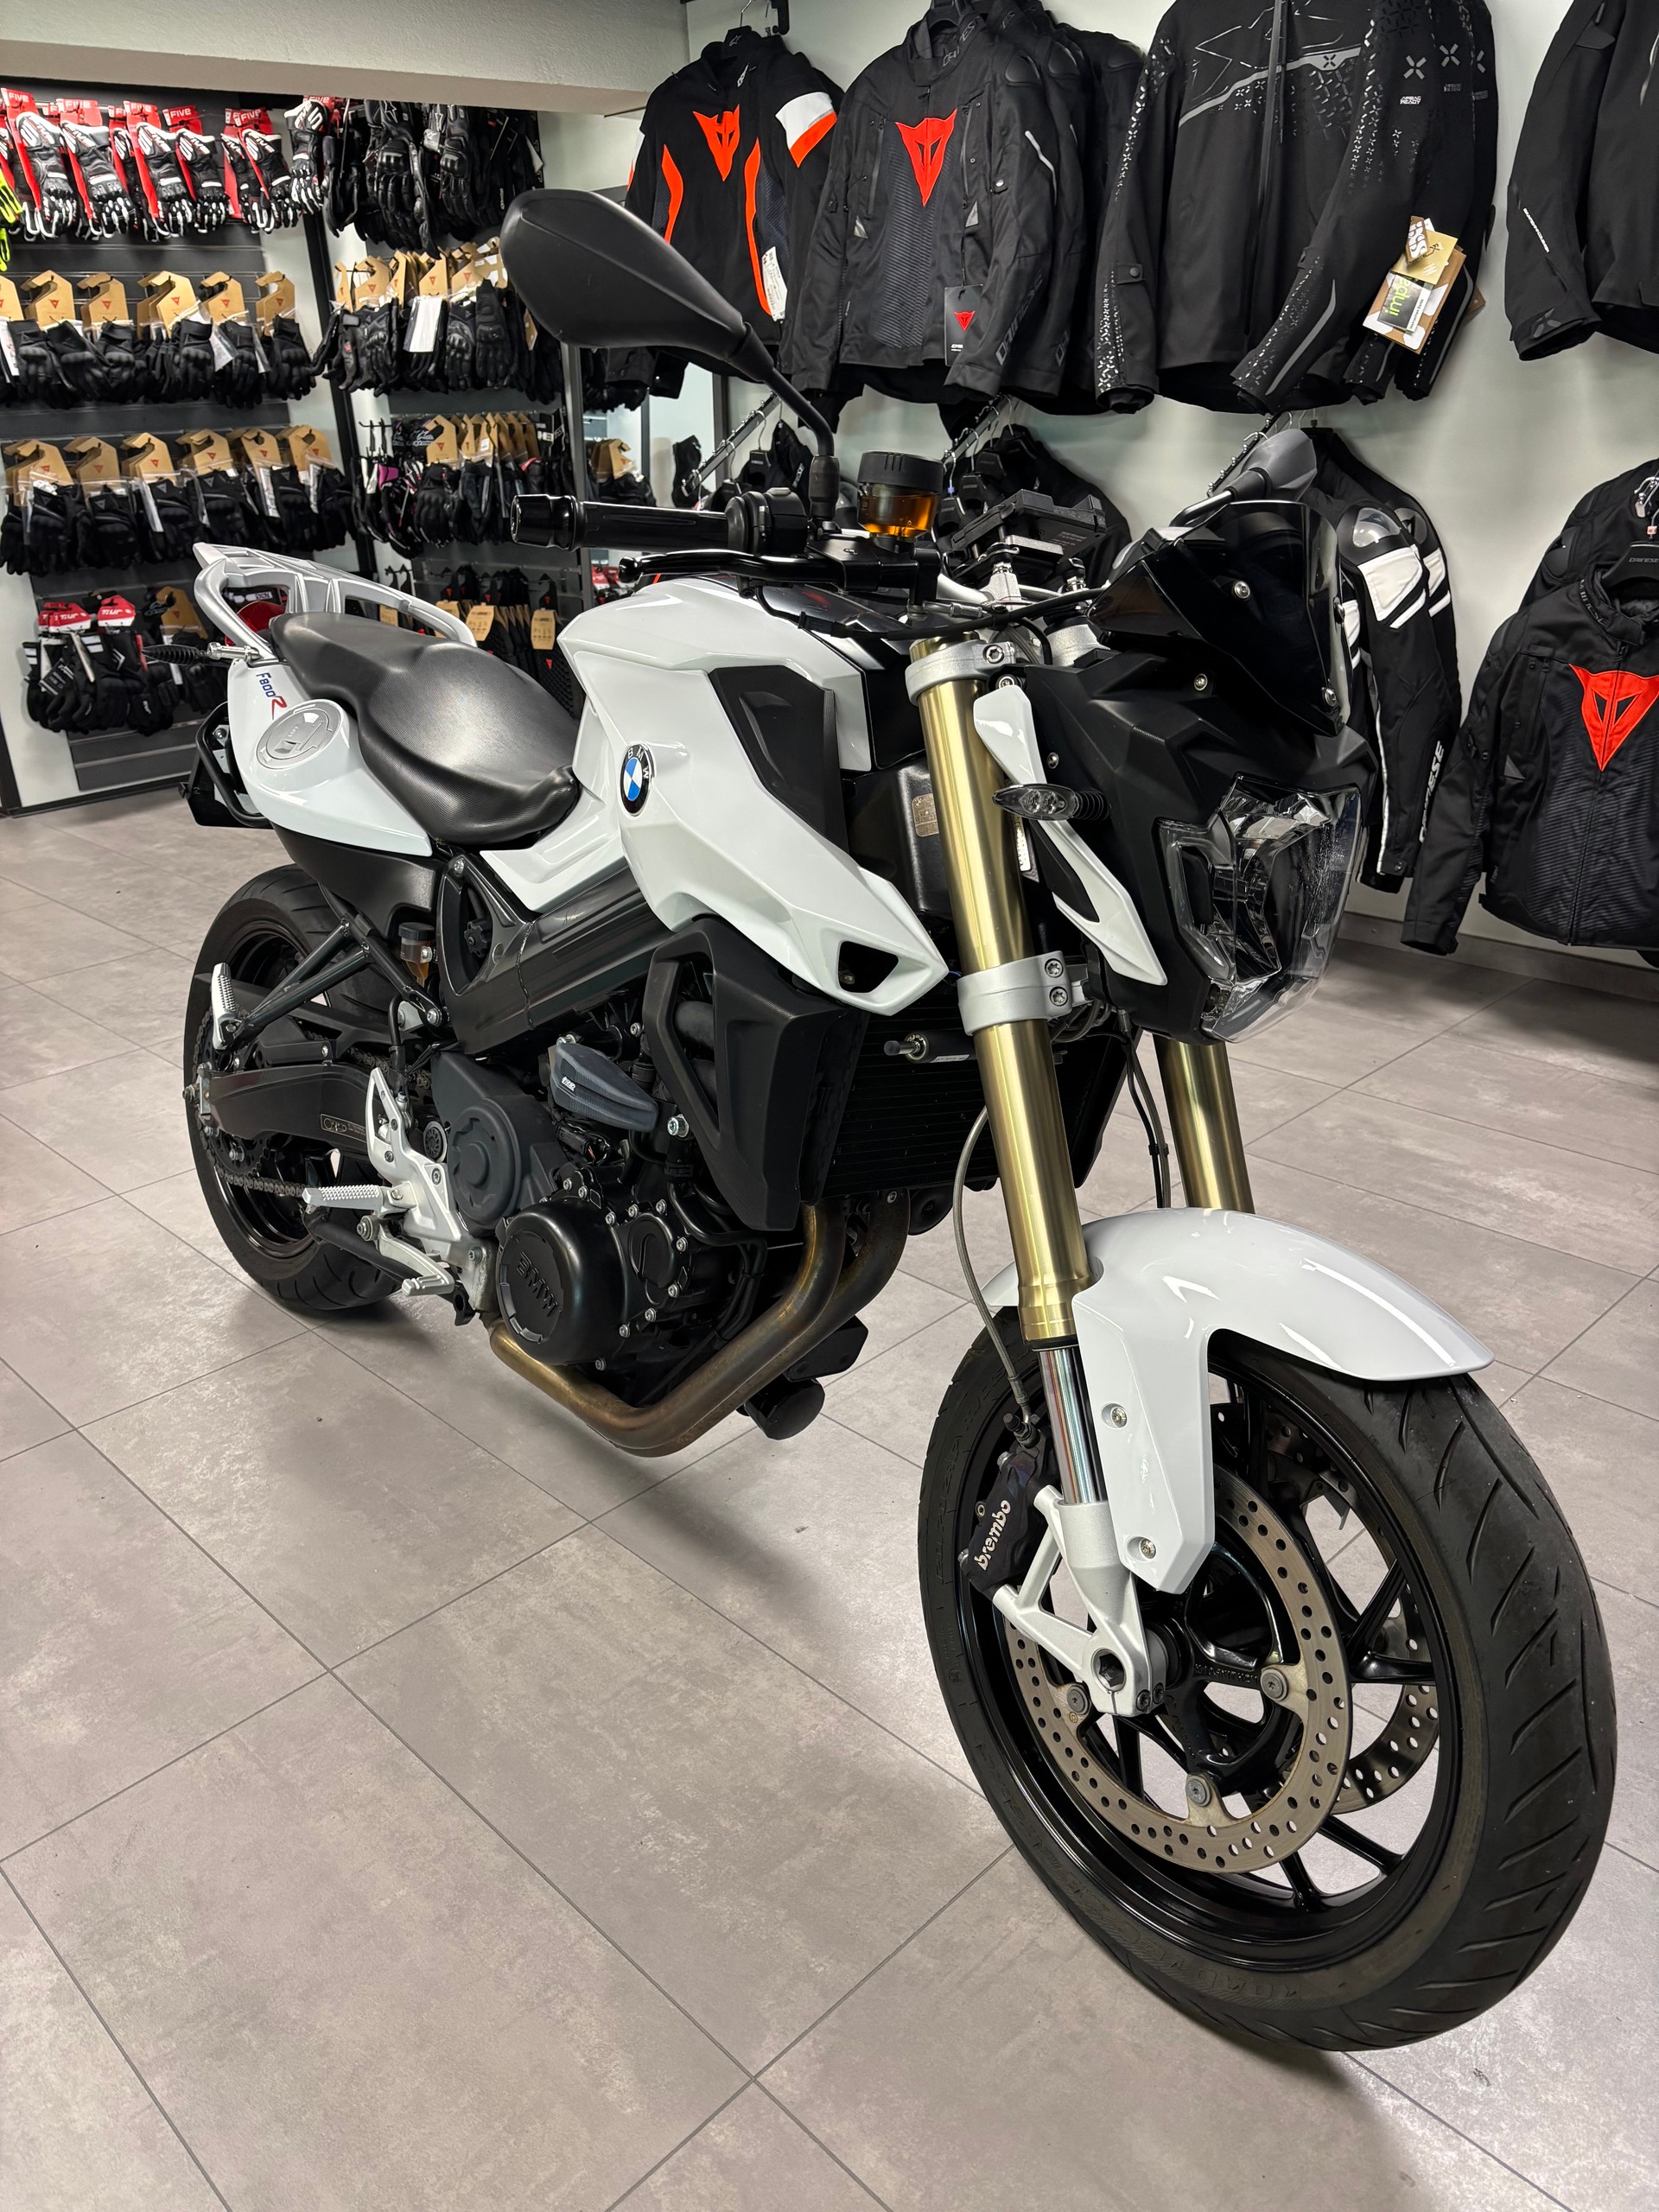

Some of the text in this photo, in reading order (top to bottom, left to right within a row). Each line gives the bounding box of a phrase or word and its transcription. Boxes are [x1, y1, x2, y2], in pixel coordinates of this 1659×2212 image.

[9, 92, 29, 103] FIVE
[169, 107, 192, 118] FIVE
[240, 109, 262, 122] FIVE
[1409, 308, 1420, 329] Instruction
[256, 671, 288, 721] F800R
[627, 746, 649, 779] BMW
[516, 1251, 559, 1318] BMW
[973, 1499, 1012, 1571] brembo
